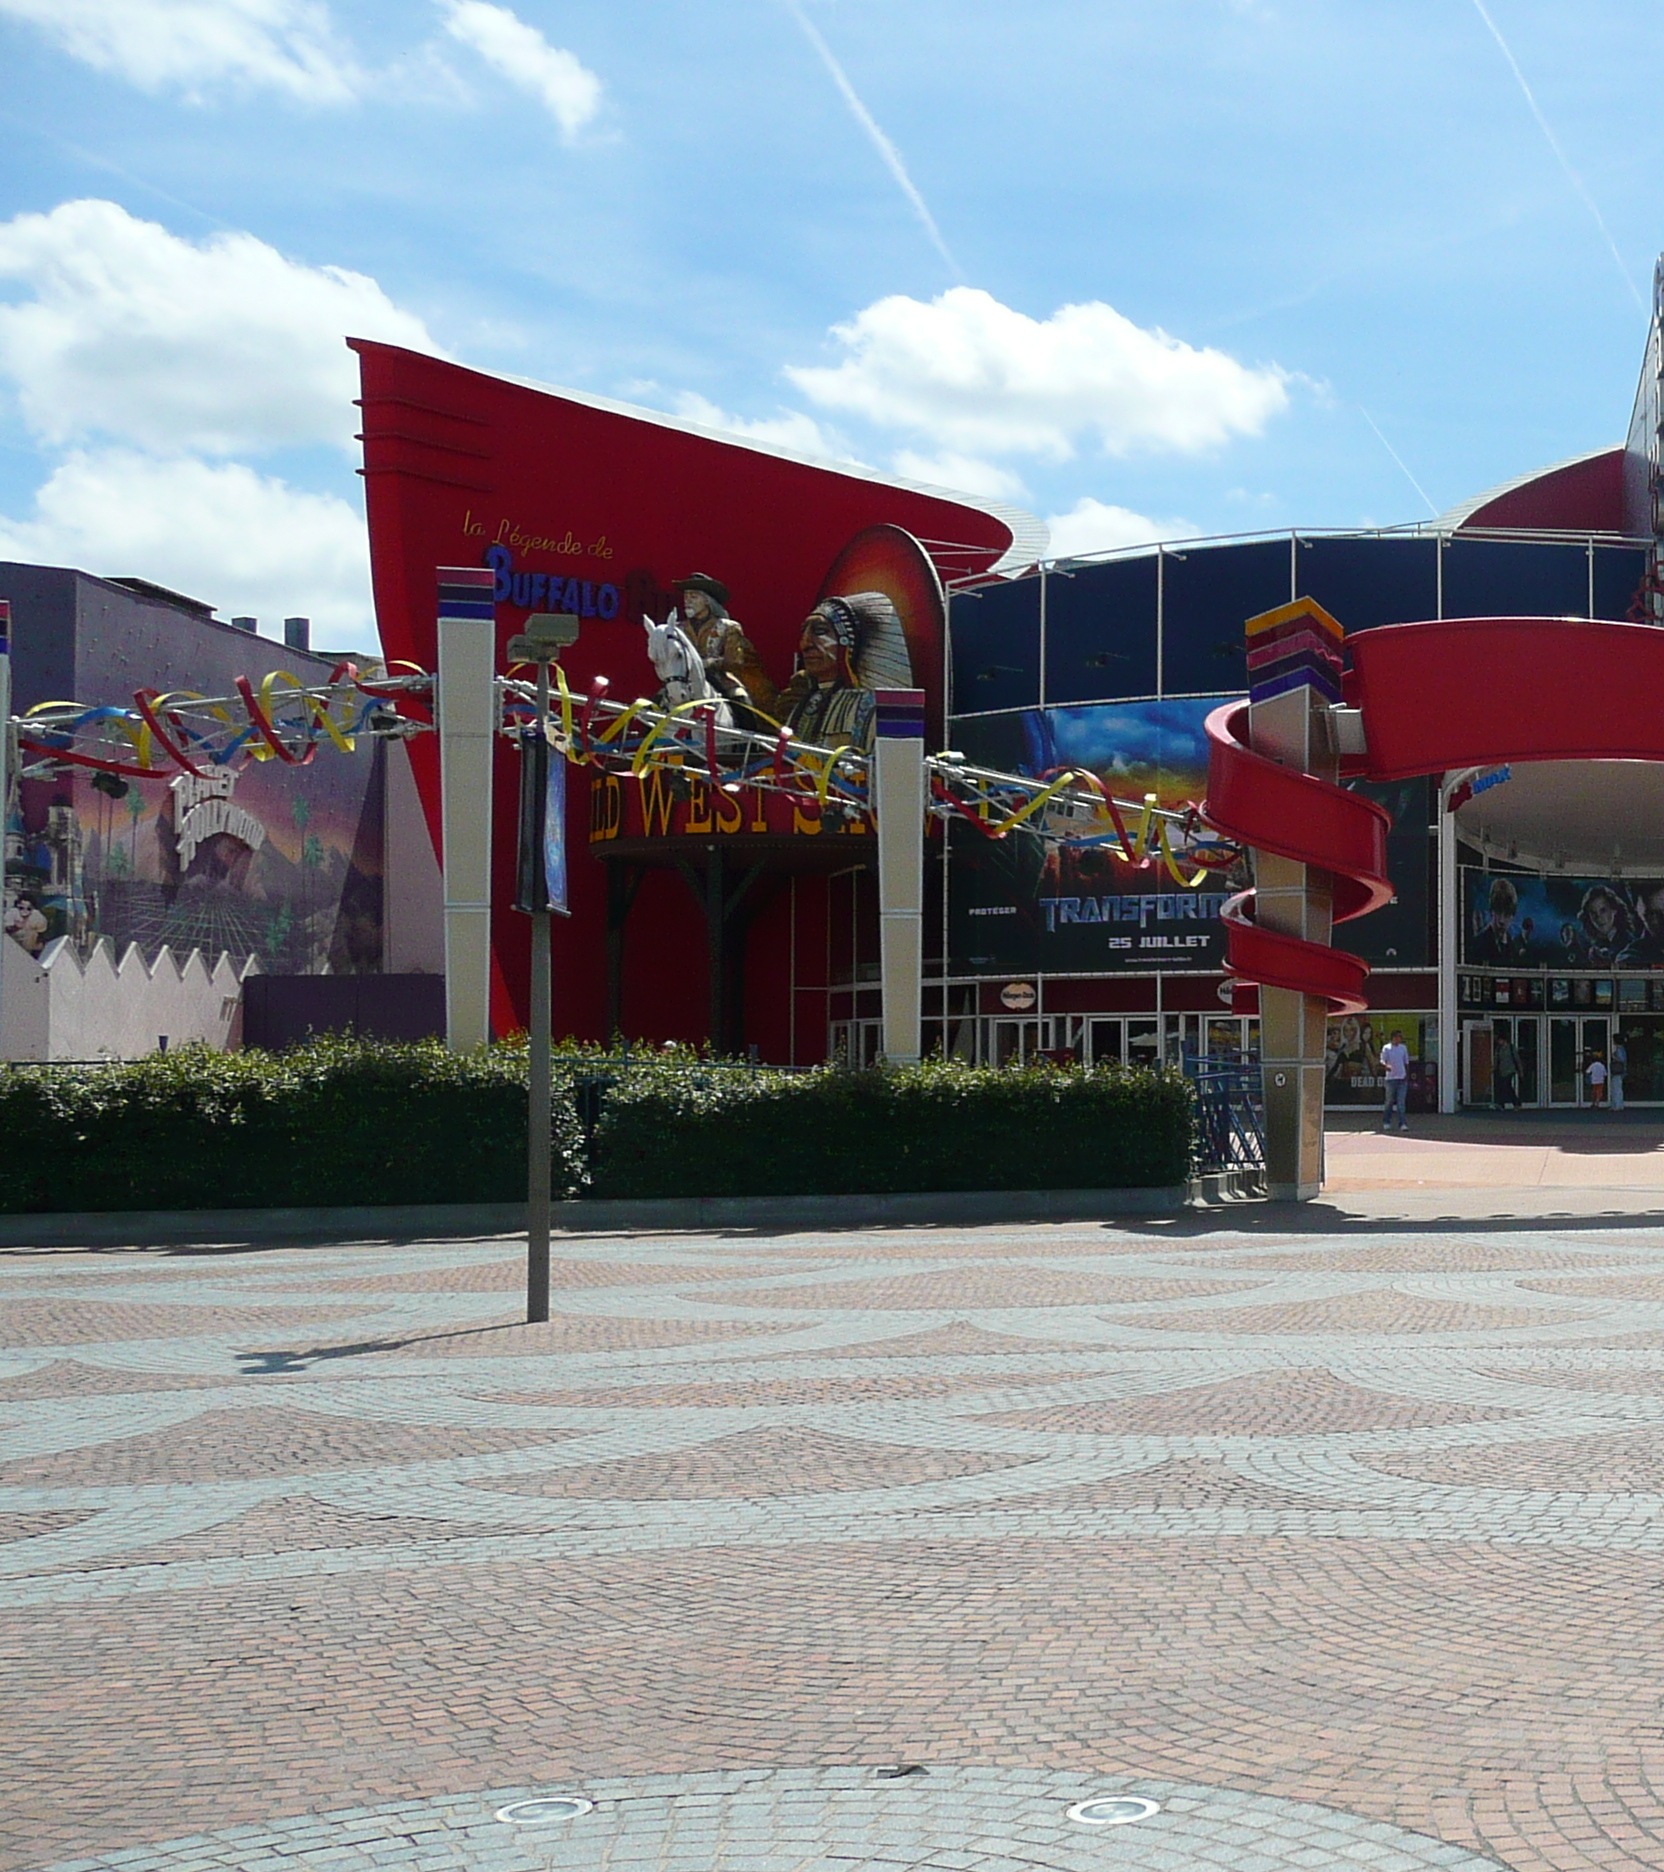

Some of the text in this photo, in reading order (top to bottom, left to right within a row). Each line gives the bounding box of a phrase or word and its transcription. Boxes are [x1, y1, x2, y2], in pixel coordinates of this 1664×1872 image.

[587, 535, 614, 560] de
[484, 545, 620, 620] BUFFALO
[176, 798, 265, 872] HOLLYWOOD
[1038, 893, 1240, 933] TRANSFORM
[1108, 935, 1211, 949] 25 JUILLET
[1350, 1076, 1375, 1088] DEAD
